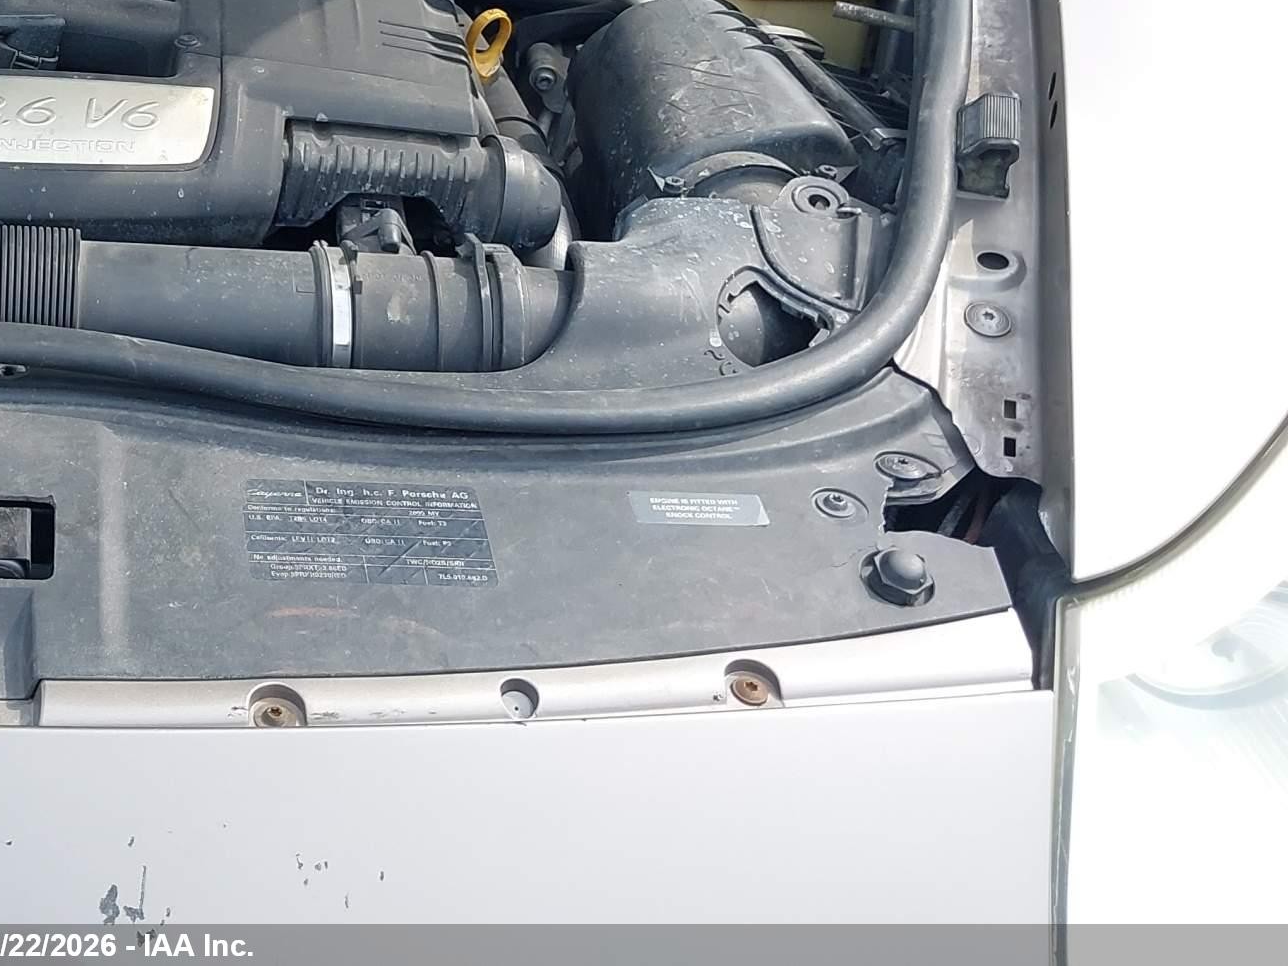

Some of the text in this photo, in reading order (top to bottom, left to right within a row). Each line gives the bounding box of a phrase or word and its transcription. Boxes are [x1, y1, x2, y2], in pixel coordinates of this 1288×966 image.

[85, 97, 161, 131] V6
[402, 490, 446, 499] Porsche
[451, 491, 469, 500] AG
[312, 497, 343, 505] VEHICLE
[425, 501, 478, 509] INFORMATION
